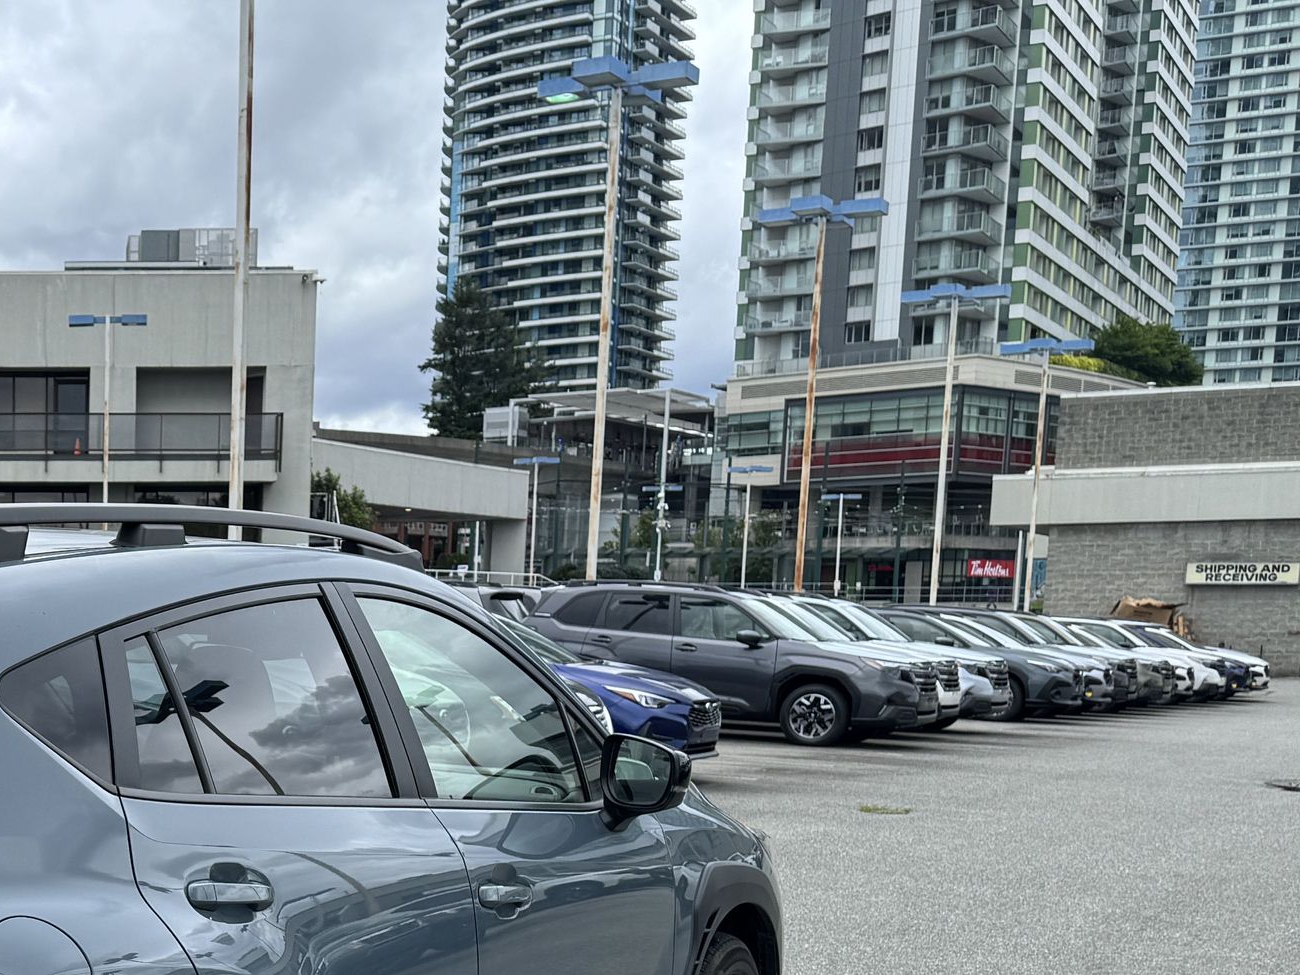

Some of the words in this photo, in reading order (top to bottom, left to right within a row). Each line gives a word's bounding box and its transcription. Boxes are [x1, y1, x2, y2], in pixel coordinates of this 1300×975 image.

[970, 560, 984, 577] Tim
[983, 560, 1009, 577] Hortons
[1195, 564, 1257, 573] SHIPPING
[1261, 564, 1291, 573] AND
[1205, 573, 1278, 582] RECEIVING
